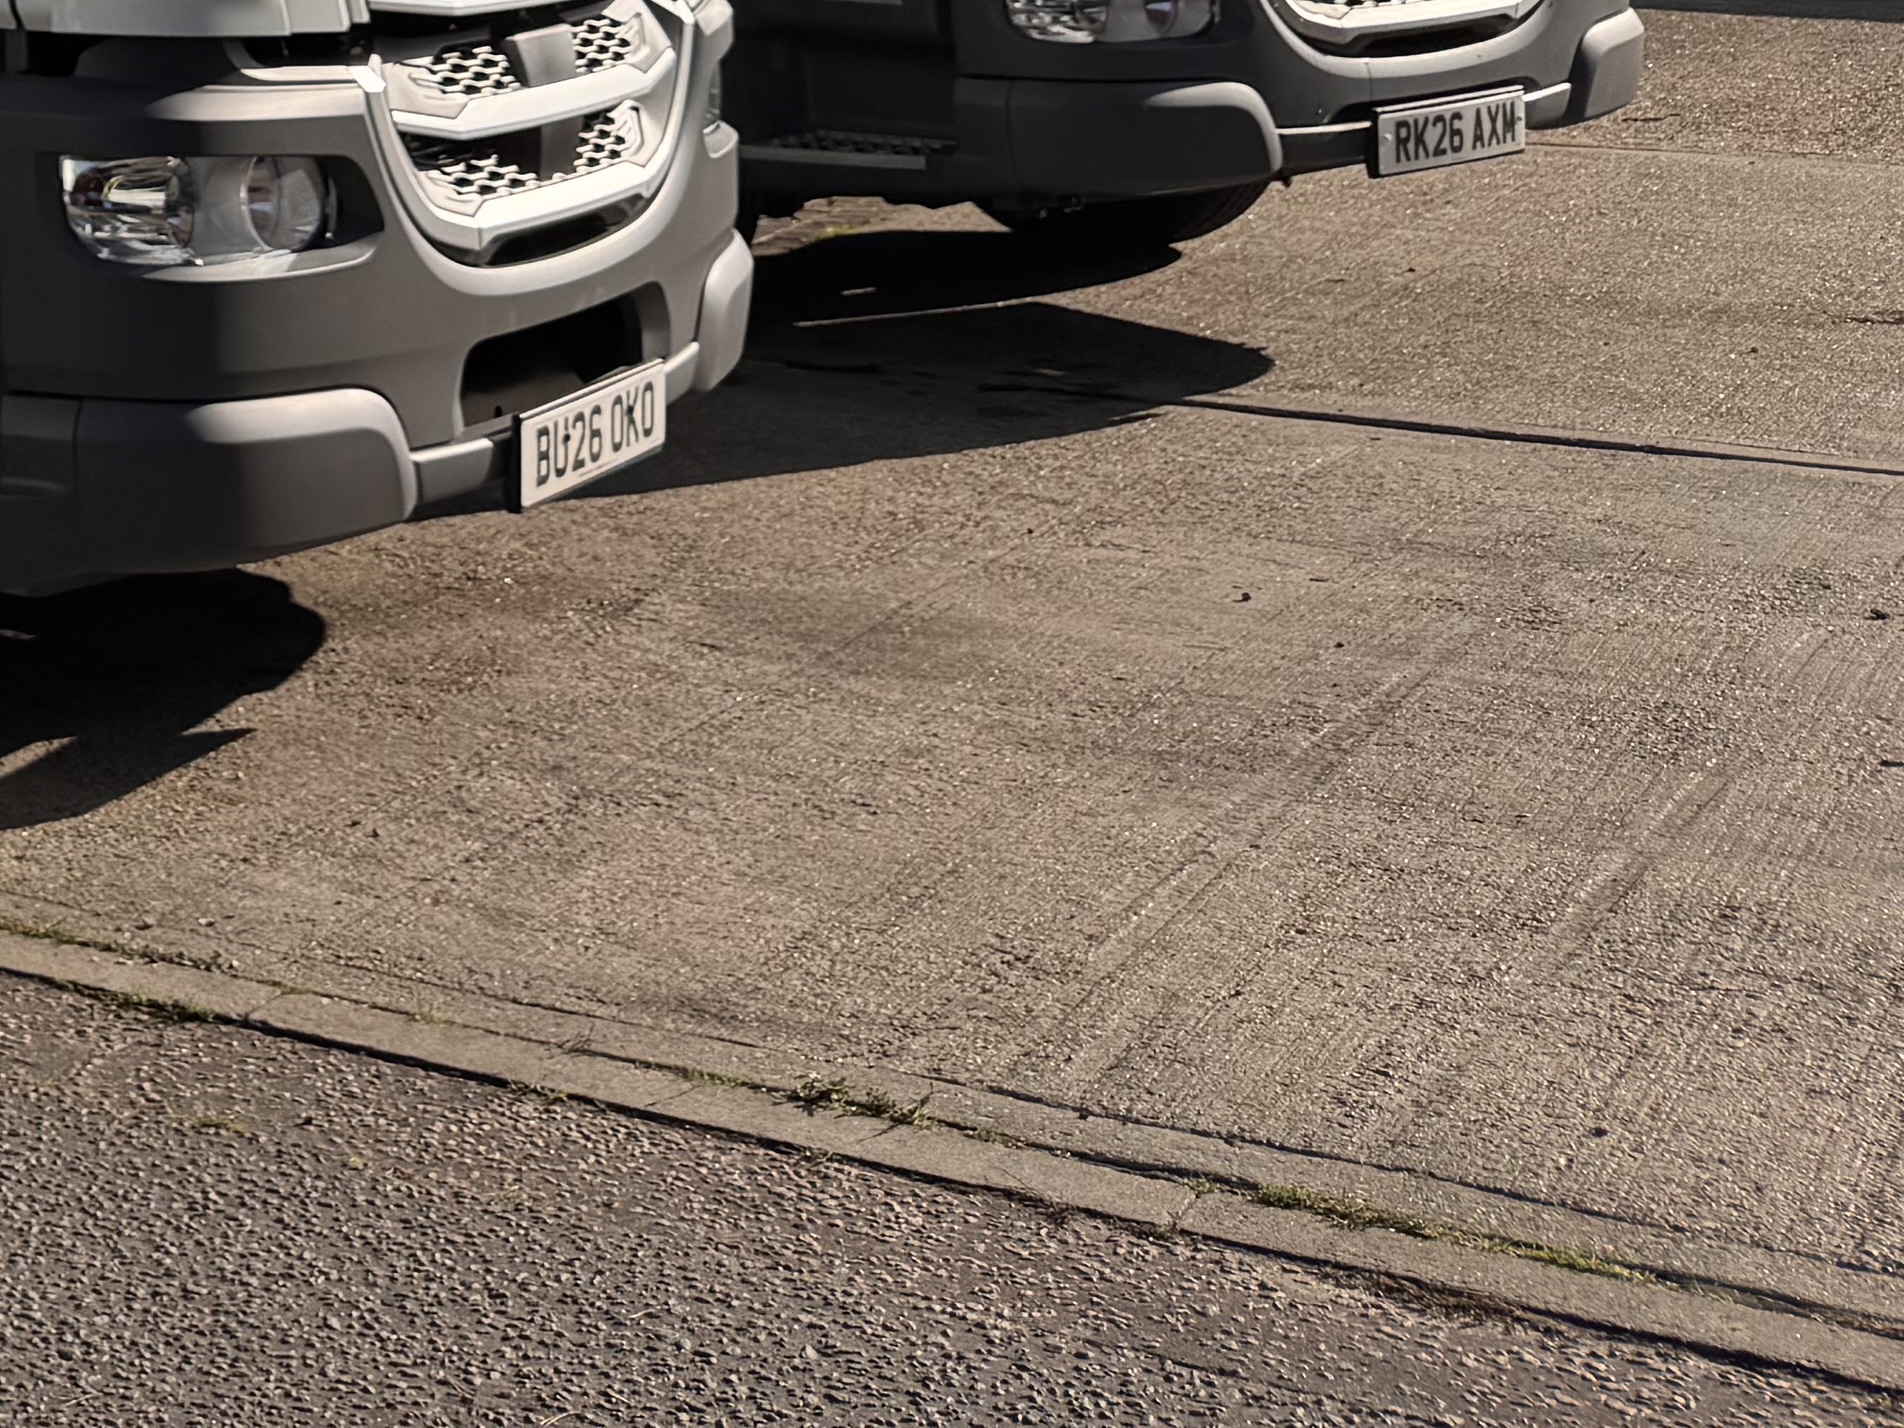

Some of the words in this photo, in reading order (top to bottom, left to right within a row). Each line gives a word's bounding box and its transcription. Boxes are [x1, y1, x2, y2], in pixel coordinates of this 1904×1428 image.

[1395, 111, 1464, 164] RK26
[1472, 101, 1516, 150] AXM
[536, 405, 602, 487] BU26
[610, 381, 655, 453] OKO
